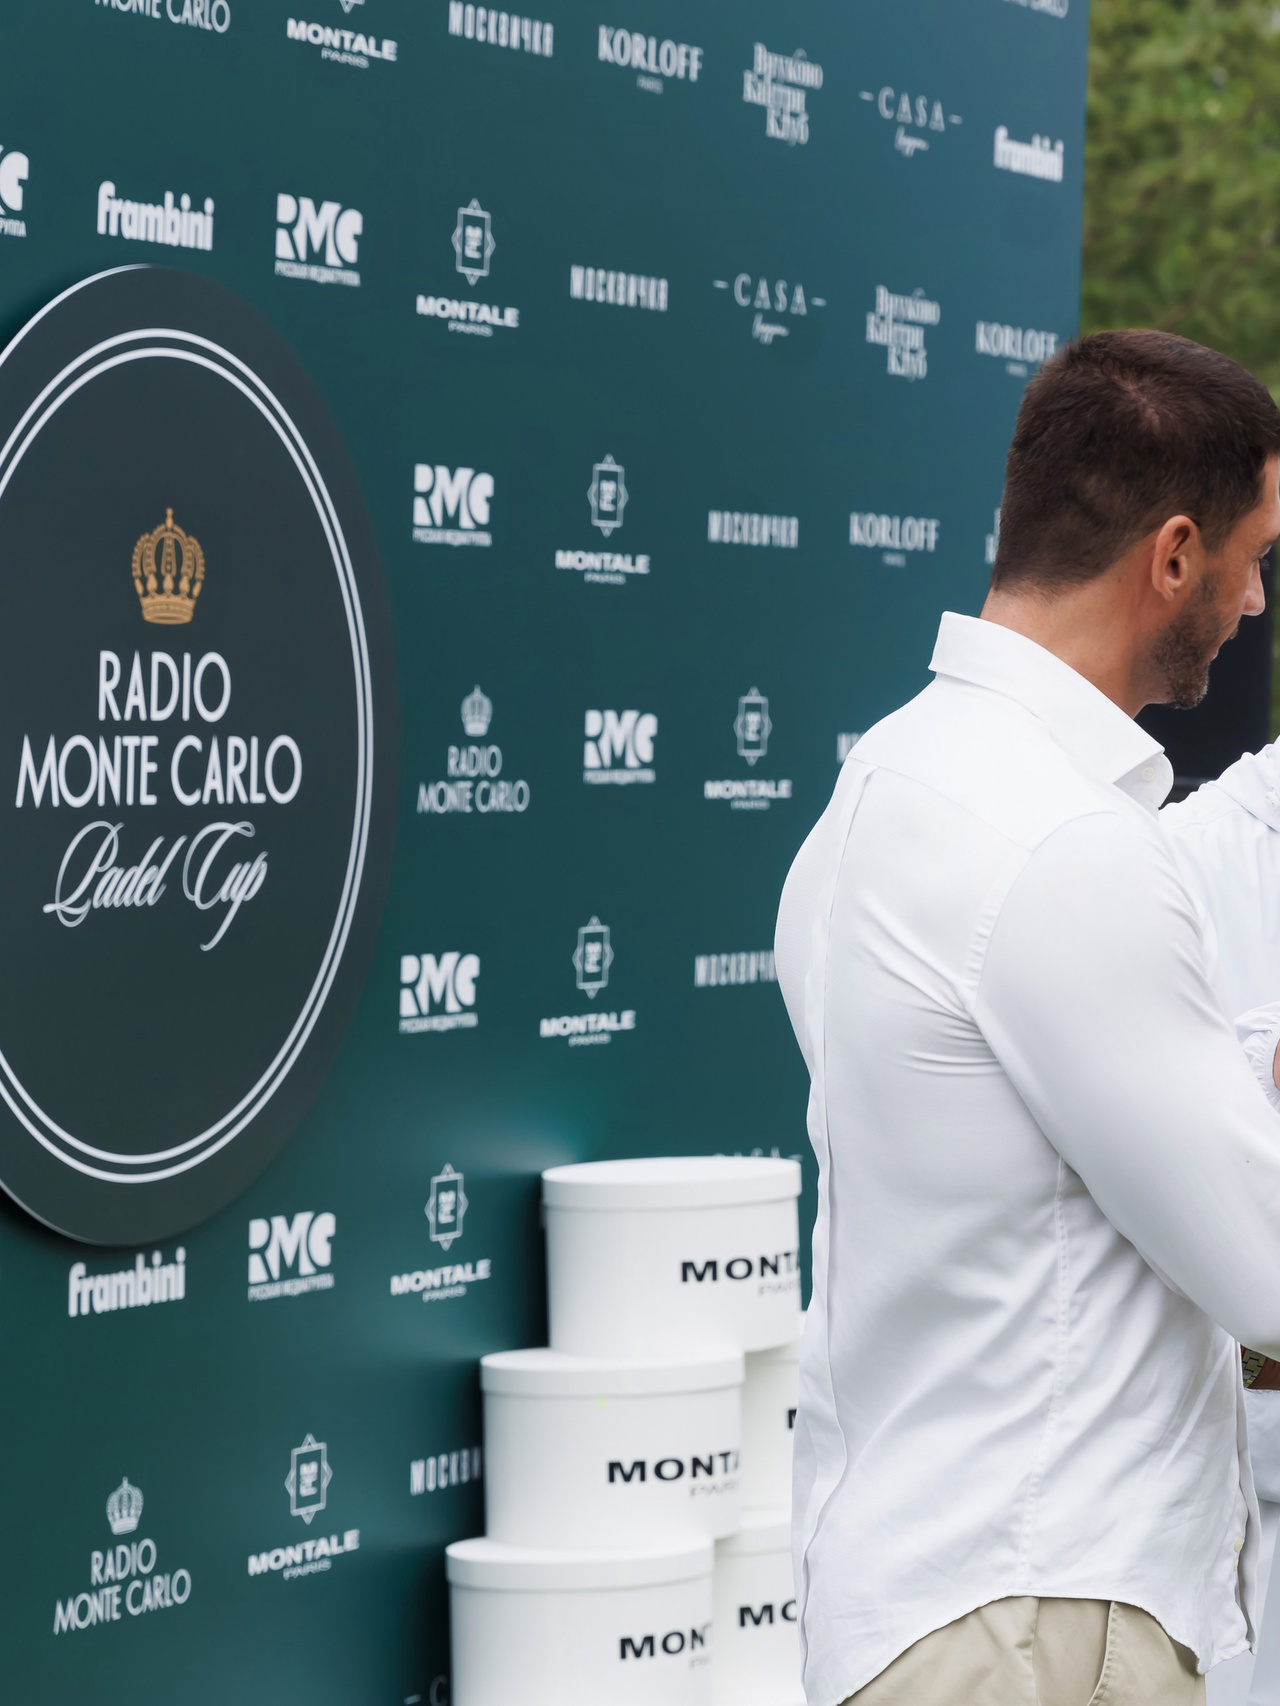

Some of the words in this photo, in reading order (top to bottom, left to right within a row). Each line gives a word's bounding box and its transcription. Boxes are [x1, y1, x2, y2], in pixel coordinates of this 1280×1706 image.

[287, 18, 398, 62] MONTALE
[448, 0, 554, 57] МОСКВИЧКА
[598, 24, 704, 82] KORLOFF
[877, 86, 946, 132] CASA
[97, 180, 215, 251] frambini
[416, 294, 519, 328] MONTALE
[733, 272, 808, 317] CASA
[849, 511, 940, 551] KORLOFF
[555, 549, 650, 575] MONTALE
[98, 650, 232, 723] RADIO
[15, 733, 159, 809] MONTE
[170, 734, 303, 806] CARLO
[448, 744, 503, 778] RADIO
[417, 780, 473, 814] MONTE
[475, 779, 530, 813] CARLO
[704, 779, 792, 799] MONTALE
[43, 820, 188, 928] Padel
[183, 821, 269, 952] Cup
[540, 1010, 636, 1039] MONTALE
[68, 1246, 187, 1318] frambini
[390, 1258, 491, 1296] MONTALE
[681, 1251, 799, 1282] MONT
[91, 1538, 157, 1586] RADIO
[248, 1528, 360, 1577] MONTALE
[53, 1585, 121, 1636] MONTE
[125, 1568, 192, 1617] CARLO
